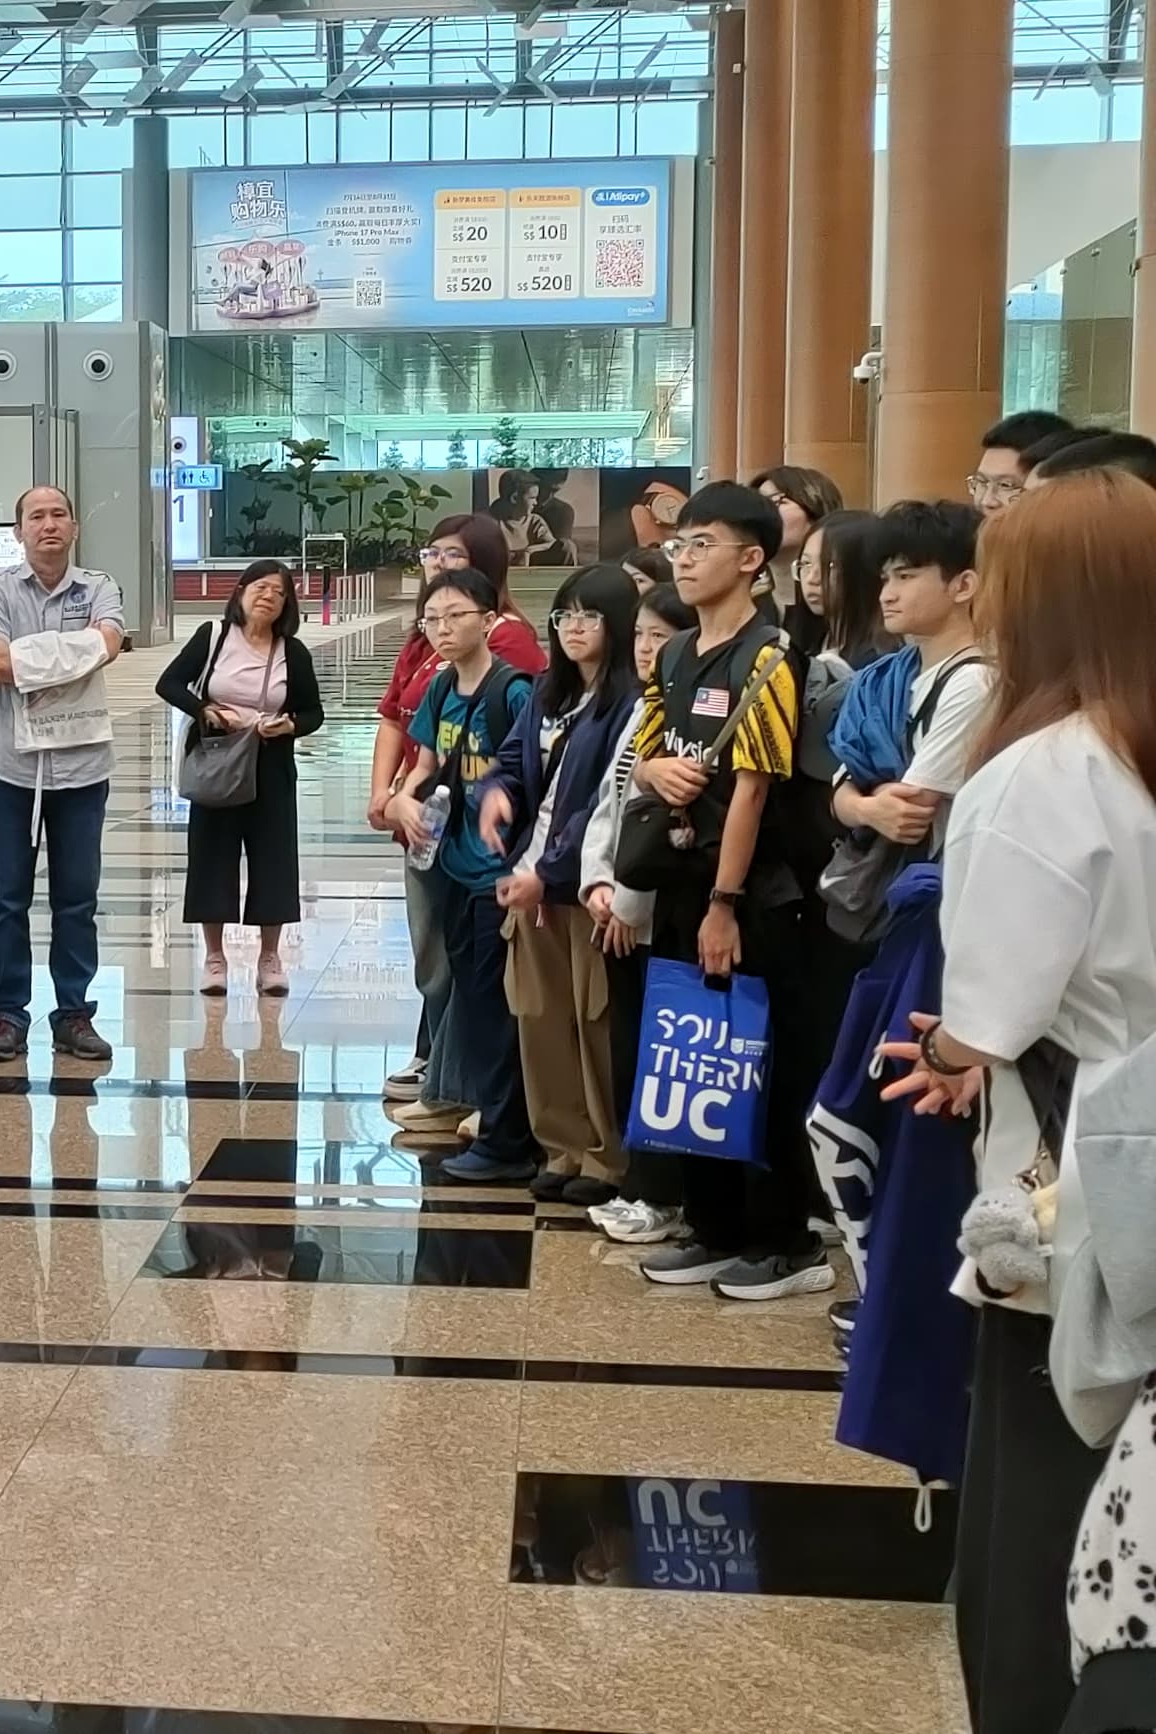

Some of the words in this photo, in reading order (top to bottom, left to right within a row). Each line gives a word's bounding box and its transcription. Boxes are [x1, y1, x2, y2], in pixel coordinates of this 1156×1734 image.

[237, 181, 274, 200] 樟宜
[231, 200, 285, 221] 购物乐
[467, 226, 488, 241] 20
[538, 225, 558, 240] 10
[461, 277, 492, 292] 520
[531, 276, 563, 291] 520
[172, 495, 185, 523] 1
[656, 1008, 729, 1050] SOU
[639, 1074, 733, 1143] UC
